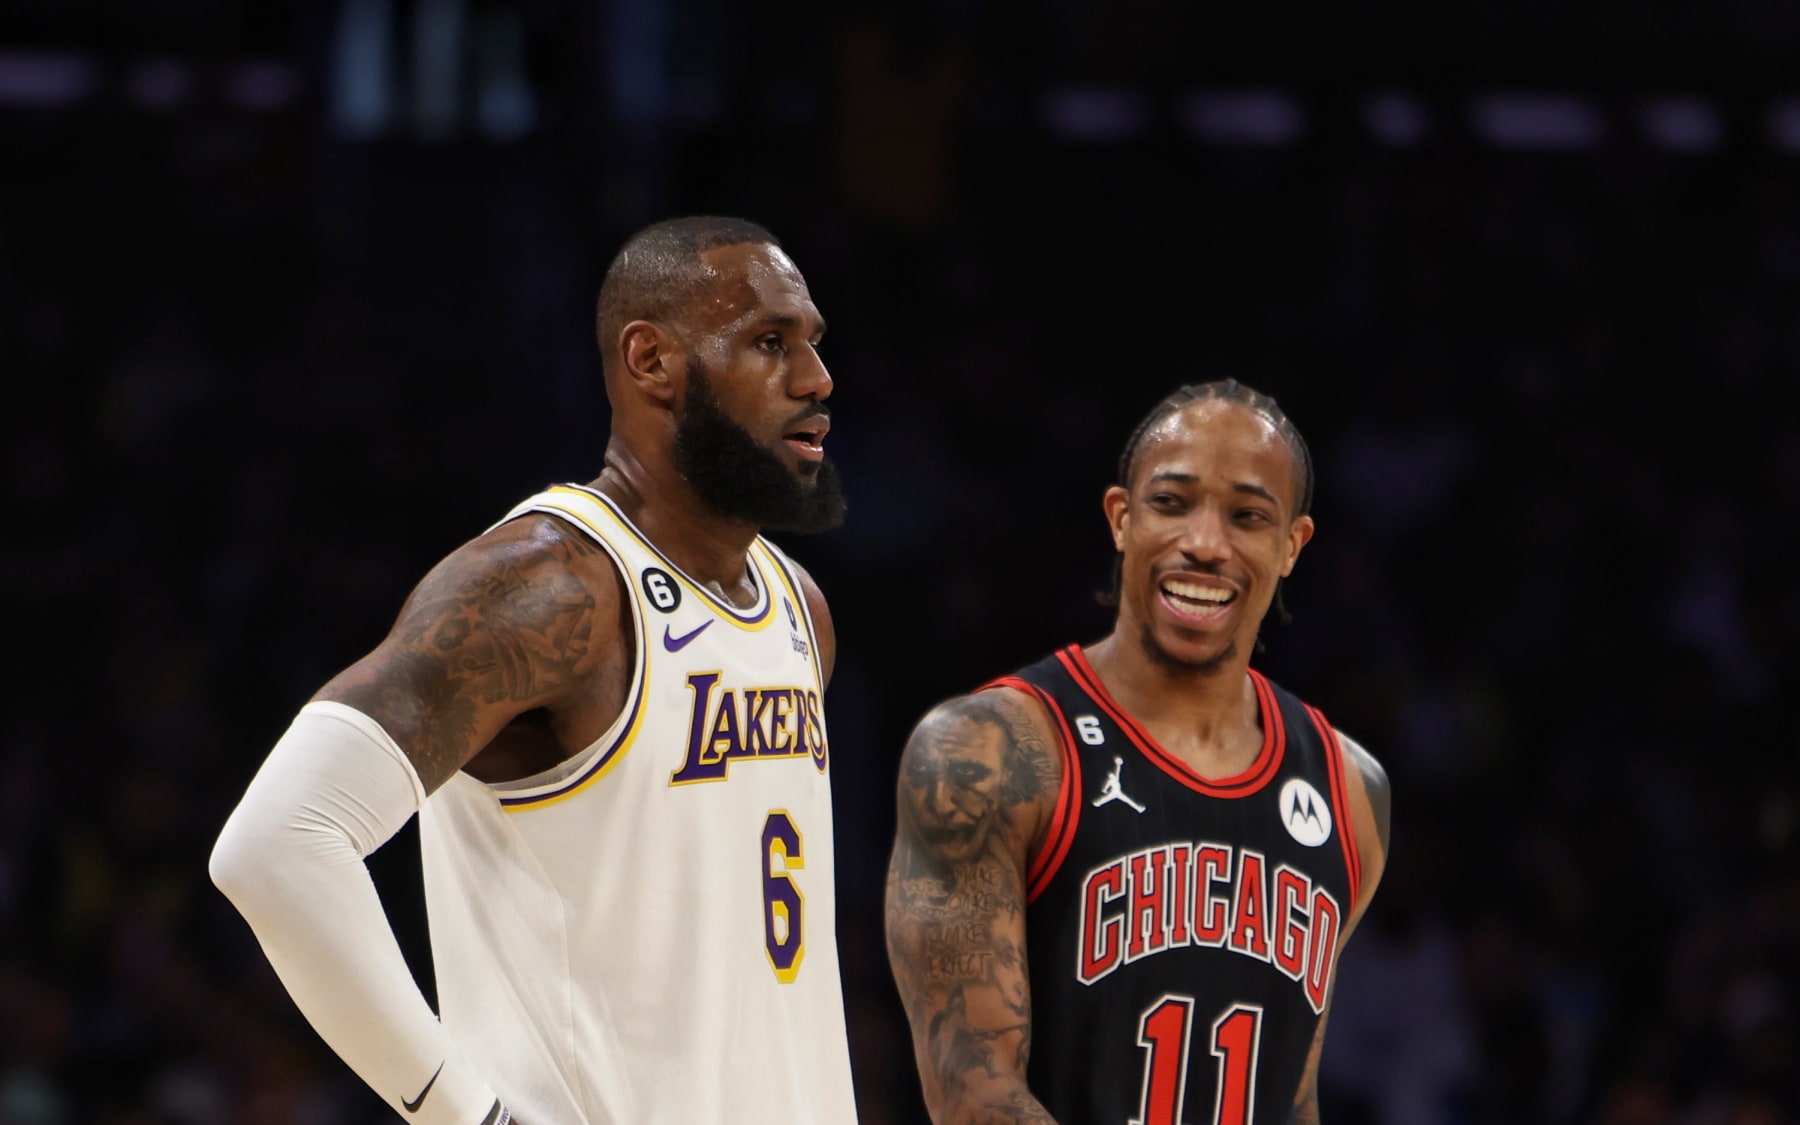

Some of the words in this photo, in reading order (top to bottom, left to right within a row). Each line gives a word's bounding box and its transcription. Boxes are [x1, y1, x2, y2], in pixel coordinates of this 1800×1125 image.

[647, 573, 676, 609] 6
[668, 670, 827, 787] LAKERS
[1075, 715, 1105, 745] 6
[761, 808, 806, 984] 6
[1076, 842, 1341, 1015] CHICAGO
